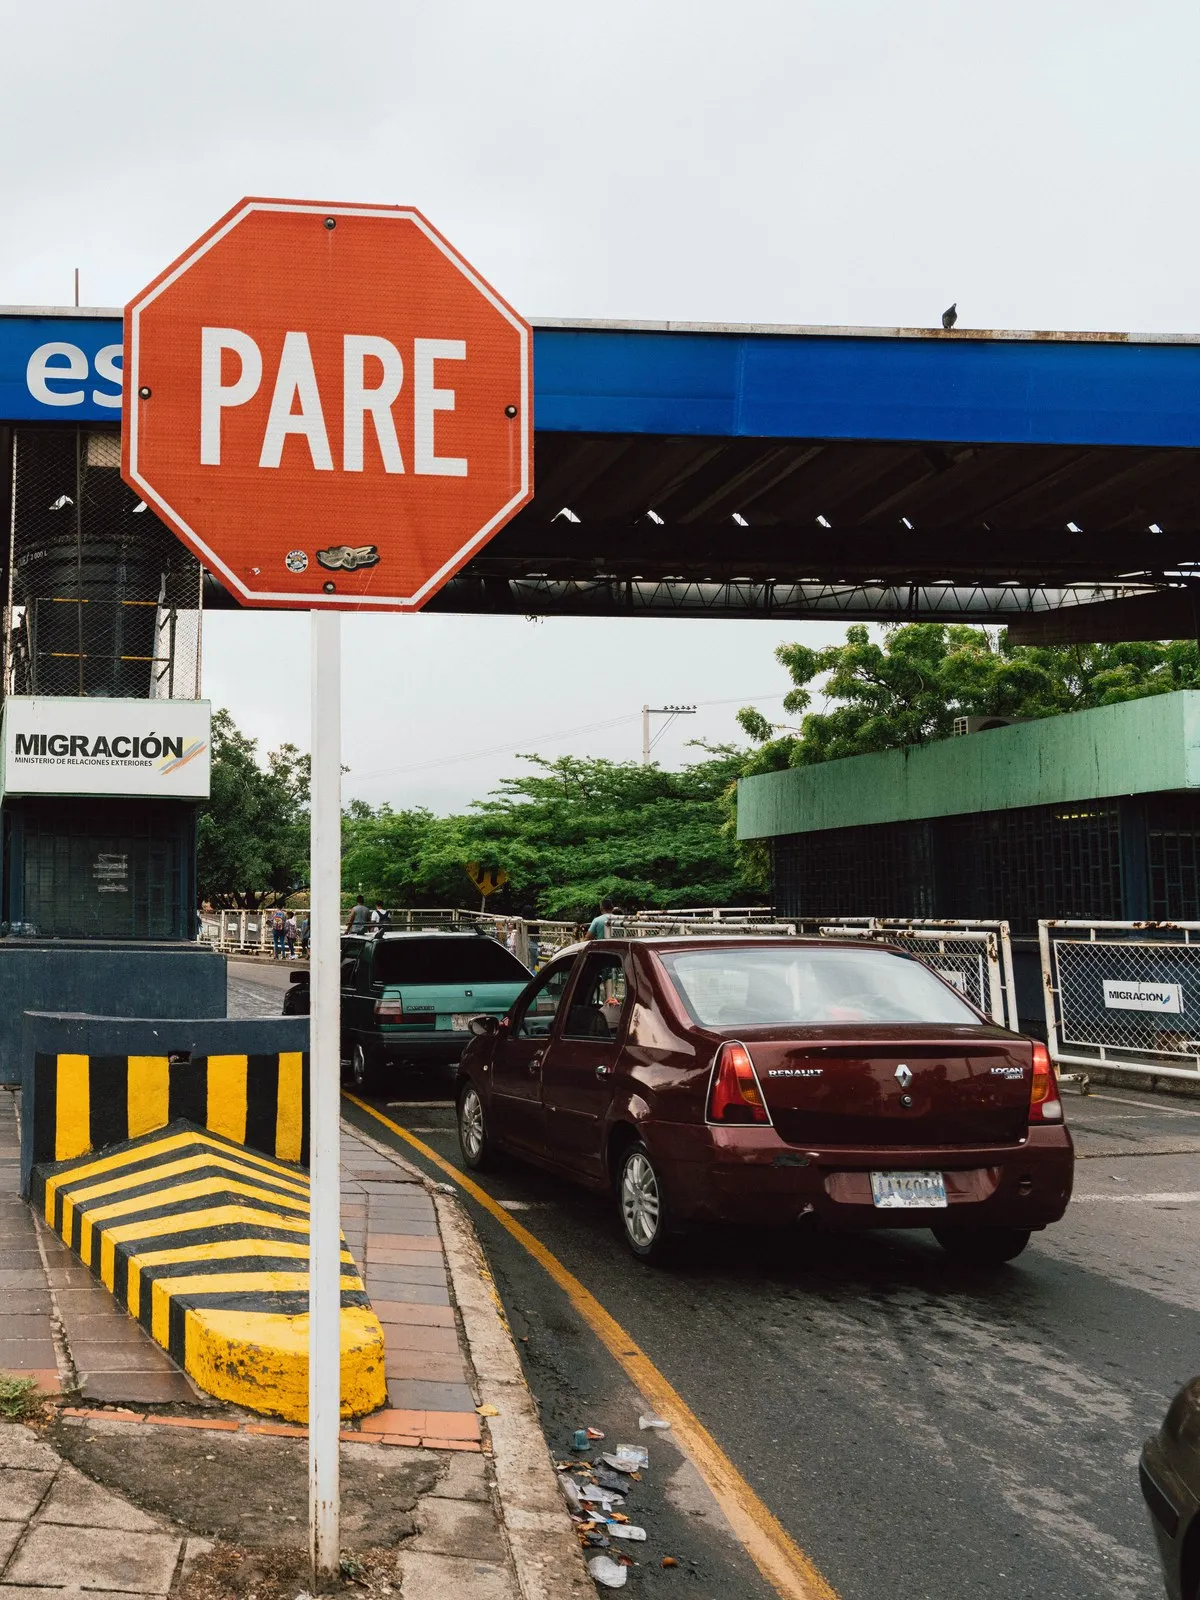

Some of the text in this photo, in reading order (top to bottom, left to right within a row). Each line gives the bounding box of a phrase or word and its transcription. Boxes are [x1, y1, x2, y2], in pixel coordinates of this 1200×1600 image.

[199, 326, 469, 477] PARE
[15, 731, 183, 759] MIGRACIÓN
[111, 759, 153, 767] EXTERIORES
[768, 1069, 823, 1078] RENAULT
[990, 1067, 1024, 1075] LOGAN
